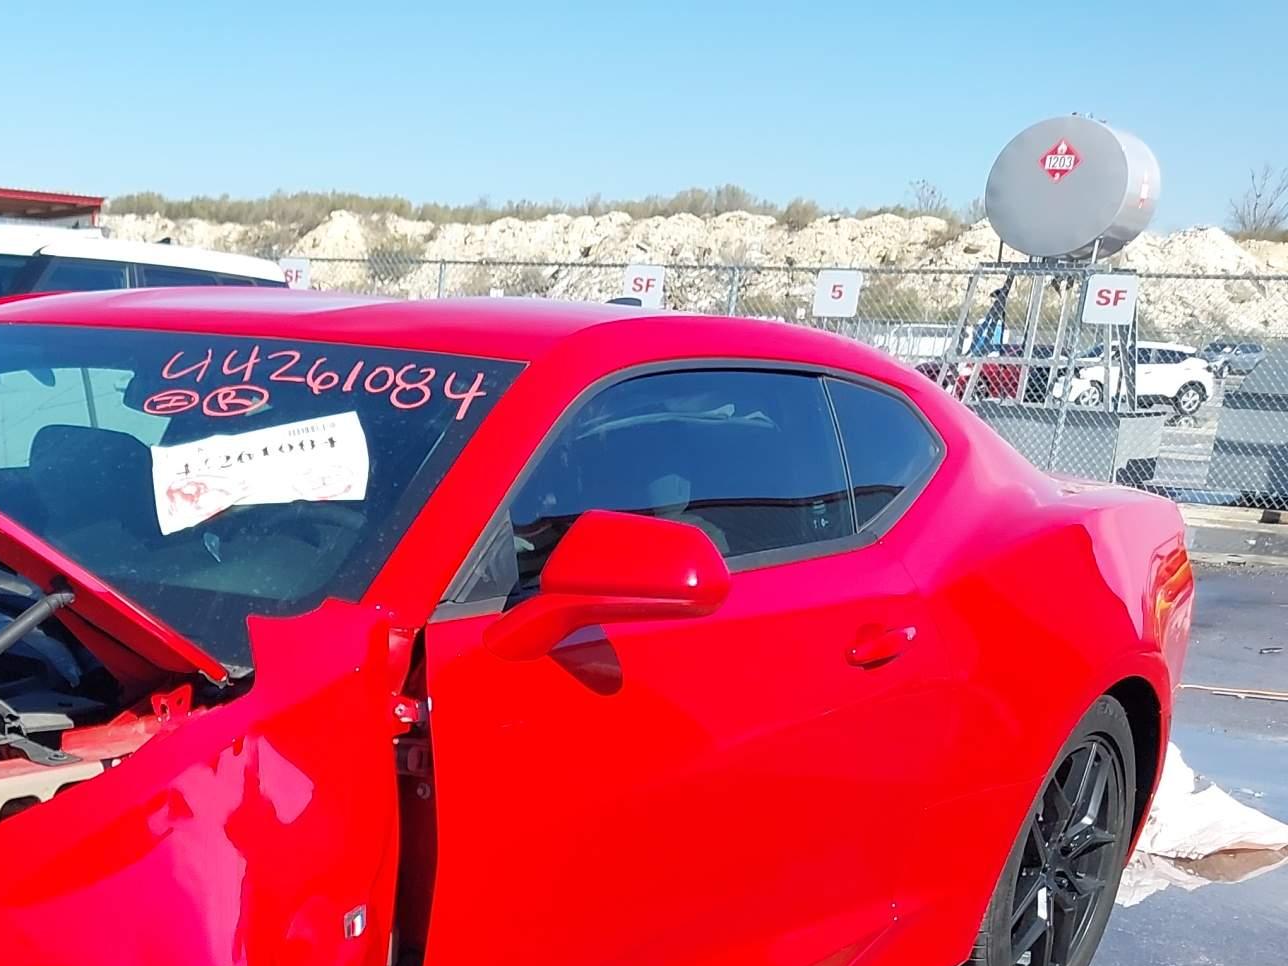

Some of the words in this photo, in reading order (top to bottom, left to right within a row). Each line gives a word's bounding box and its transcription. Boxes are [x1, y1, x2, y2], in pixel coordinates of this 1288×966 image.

[1048, 156, 1073, 168] 1203
[284, 268, 304, 284] SF
[631, 277, 657, 293] SF
[831, 284, 844, 299] 5
[1095, 288, 1128, 307] SF
[161, 344, 488, 421] 44261084
